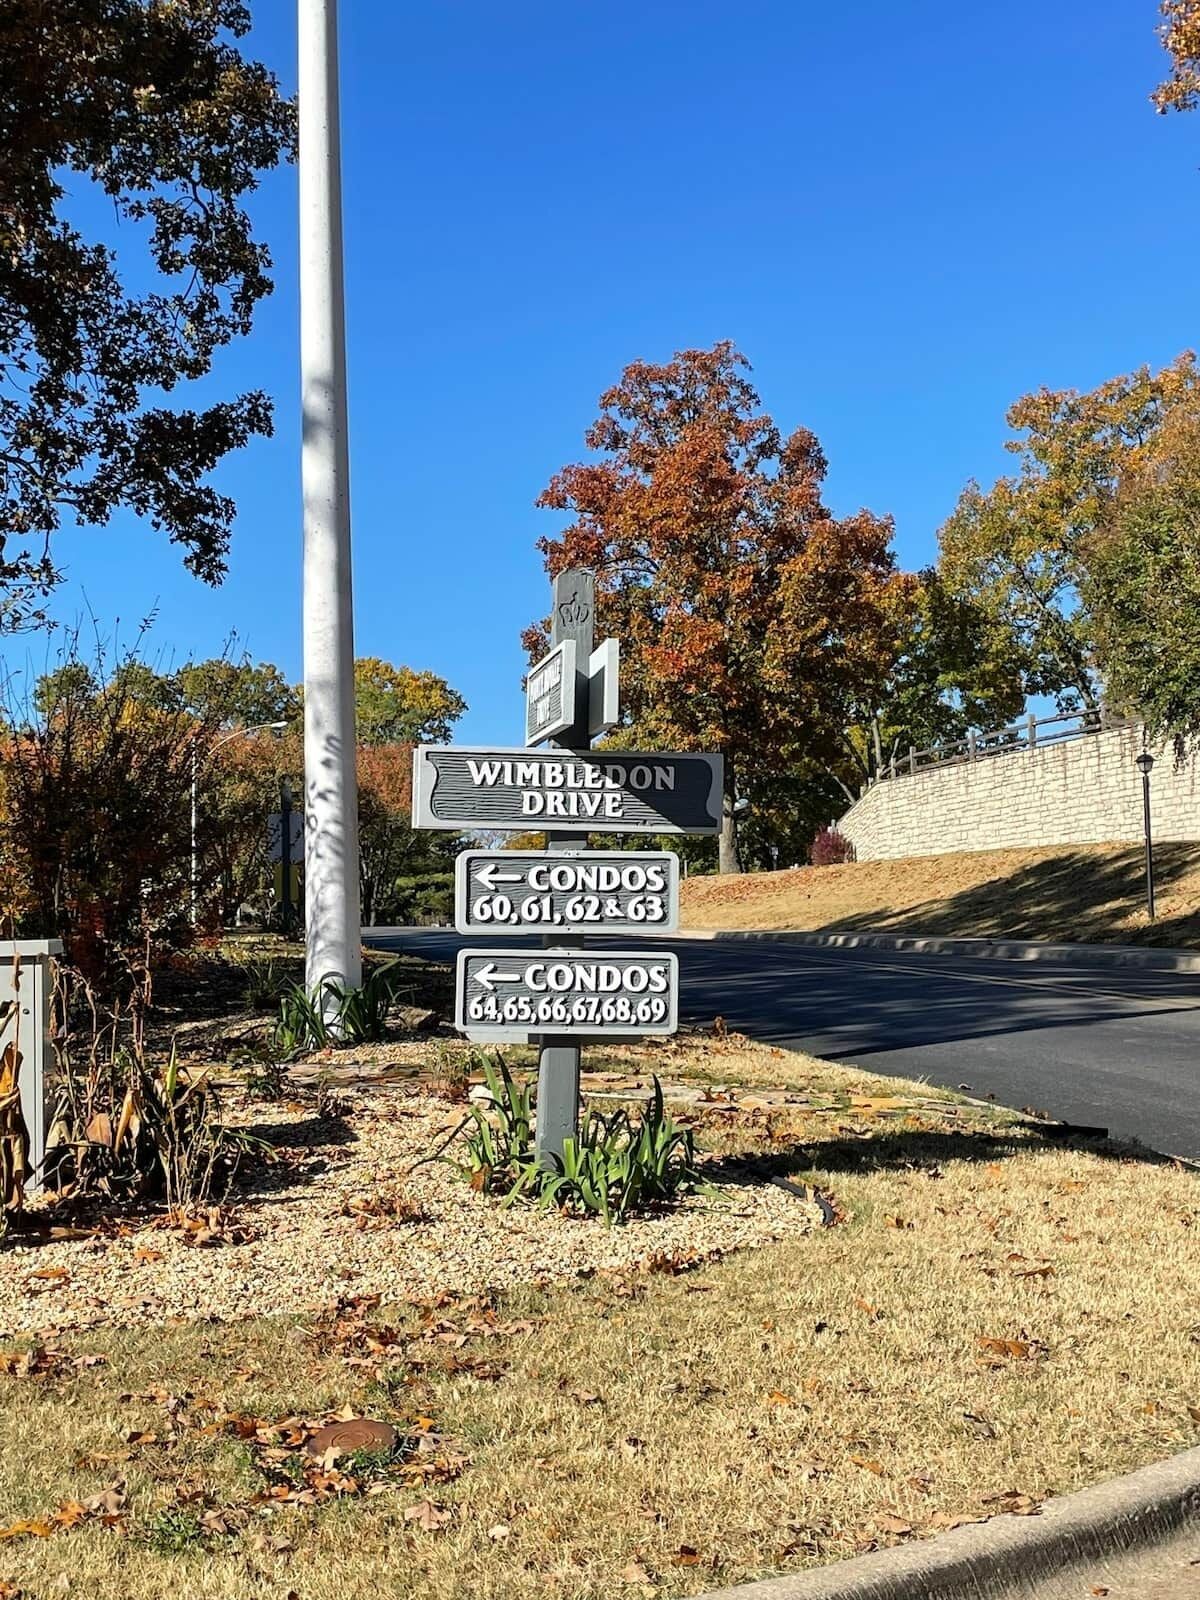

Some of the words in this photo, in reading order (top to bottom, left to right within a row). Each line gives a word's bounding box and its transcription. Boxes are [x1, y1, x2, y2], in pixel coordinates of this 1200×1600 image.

[465, 760, 676, 791] WIMBLEDON
[521, 790, 624, 818] DRIVE
[527, 865, 665, 892] CONDOS
[524, 963, 668, 993] CONDOS
